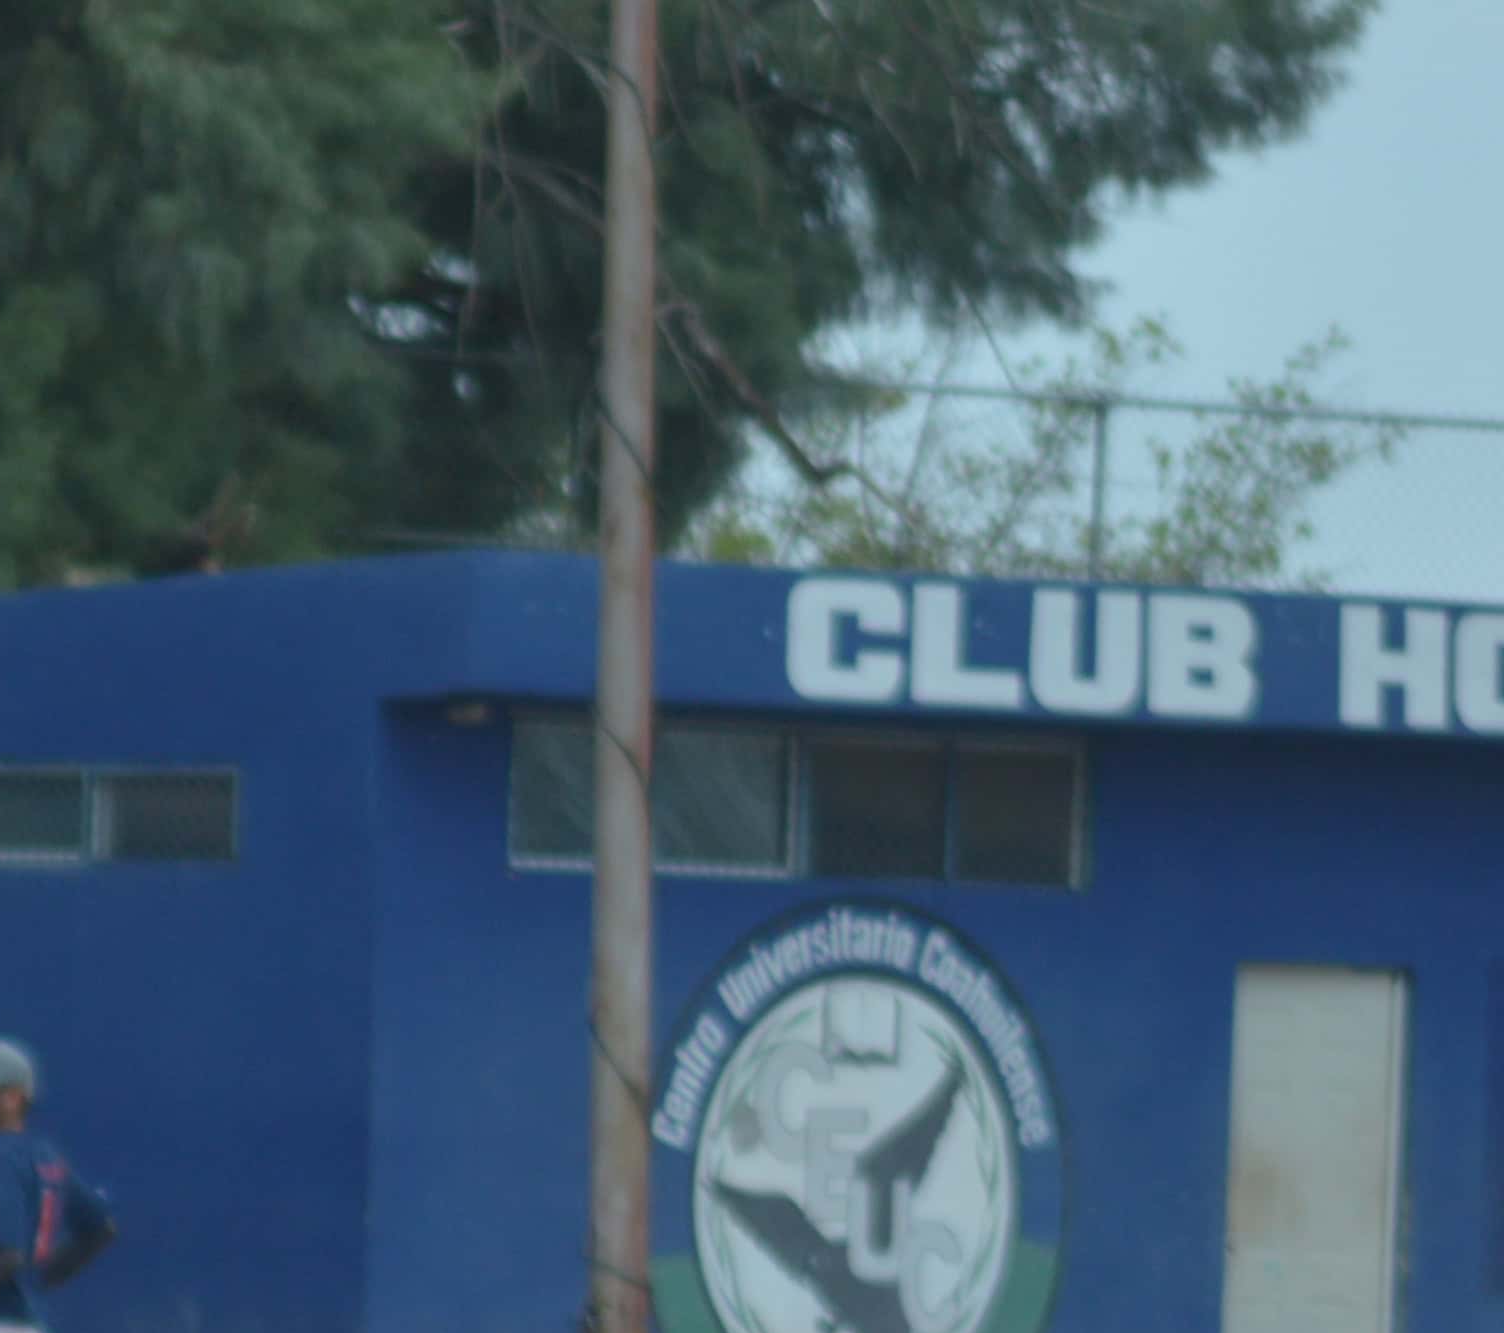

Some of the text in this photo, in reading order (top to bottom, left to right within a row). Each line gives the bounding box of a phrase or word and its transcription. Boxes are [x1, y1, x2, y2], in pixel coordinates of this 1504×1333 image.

[787, 577, 1259, 722] CLUB
[651, 1012, 728, 1152] Centro
[717, 907, 918, 1023] Universitario
